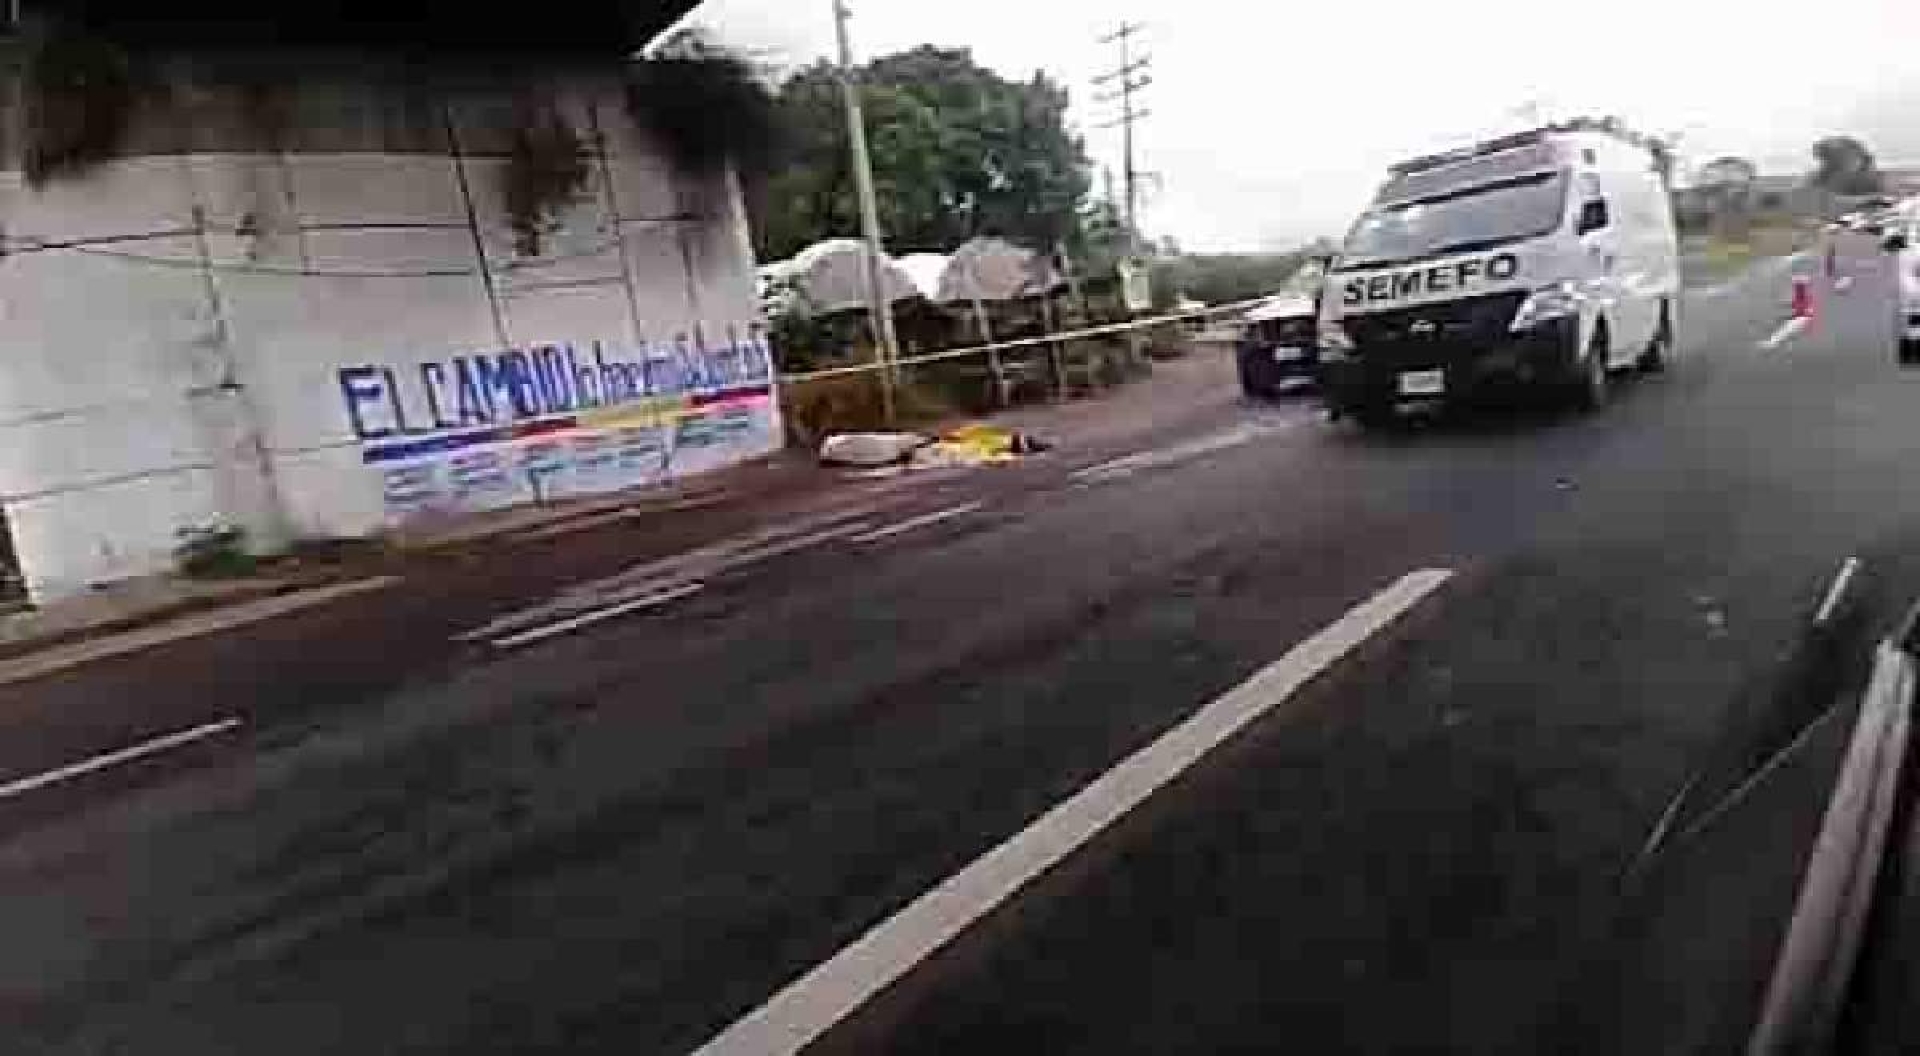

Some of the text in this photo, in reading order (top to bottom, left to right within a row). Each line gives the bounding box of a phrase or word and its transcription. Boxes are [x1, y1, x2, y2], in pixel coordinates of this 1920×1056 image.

[1344, 254, 1517, 305] SEMEFO
[338, 364, 436, 437] EL
[419, 341, 570, 428] CAMBIO
